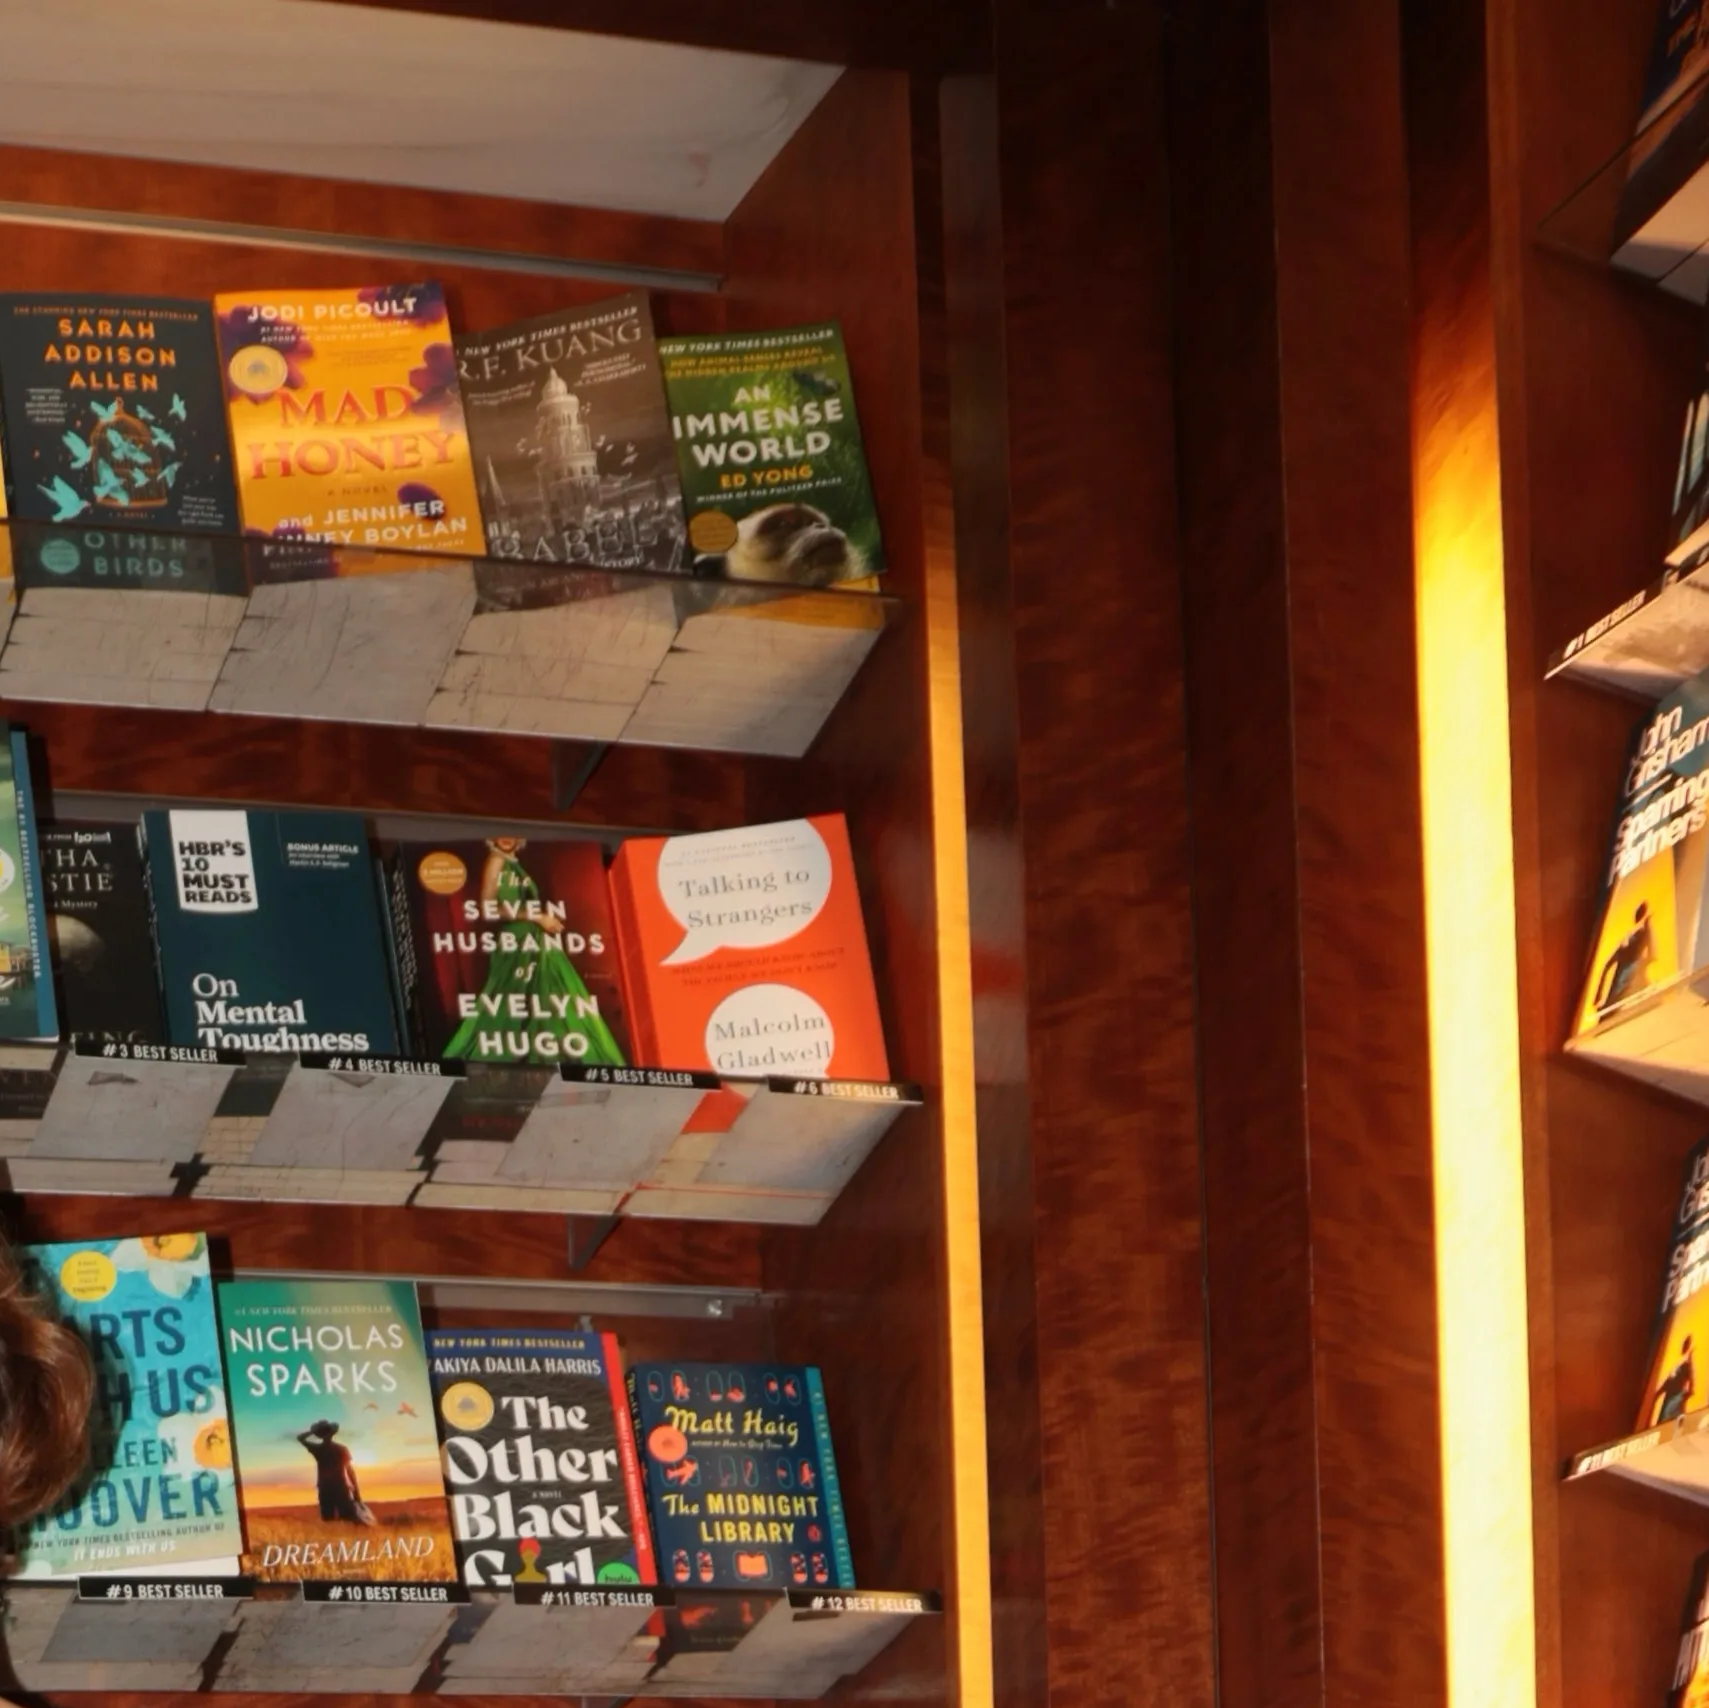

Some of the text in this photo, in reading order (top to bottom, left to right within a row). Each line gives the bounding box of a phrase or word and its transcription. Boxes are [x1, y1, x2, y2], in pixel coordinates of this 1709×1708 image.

[247, 299, 417, 322] JODI PICOULT
[58, 319, 155, 340] SARAH
[45, 343, 176, 366] ADDISON
[68, 372, 158, 391] ALLEN
[673, 399, 844, 439] IMMENSE
[692, 432, 832, 469] WORLD
[719, 466, 814, 489] ED YONG
[178, 840, 246, 857] HBR'S
[182, 859, 209, 873] 10
[183, 874, 250, 889] MUST
[677, 871, 811, 899] Talking to
[184, 891, 252, 905] READS
[464, 900, 567, 919] SEVEN
[687, 899, 814, 930] Strangers
[433, 932, 605, 953] HUSBANDS
[192, 973, 239, 999] On
[197, 999, 307, 1025] Mental
[458, 994, 600, 1018] EVELYN
[479, 1031, 589, 1057] HUGO
[613, 1068, 648, 1084] BEST
[649, 1070, 693, 1086] SELLER
[230, 1323, 404, 1353] NICHOLAS
[246, 1361, 398, 1397] SPARKS
[501, 1394, 589, 1430] The
[664, 1405, 799, 1448] Matt Haig
[447, 1436, 618, 1485] Other
[453, 1491, 627, 1541] Black
[662, 1492, 819, 1517] The MIDNIGHT
[700, 1521, 795, 1544] LIBRARY
[262, 1537, 434, 1568] DREAMLAND
[365, 1586, 397, 1601] BEST
[400, 1587, 448, 1601] SELLER
